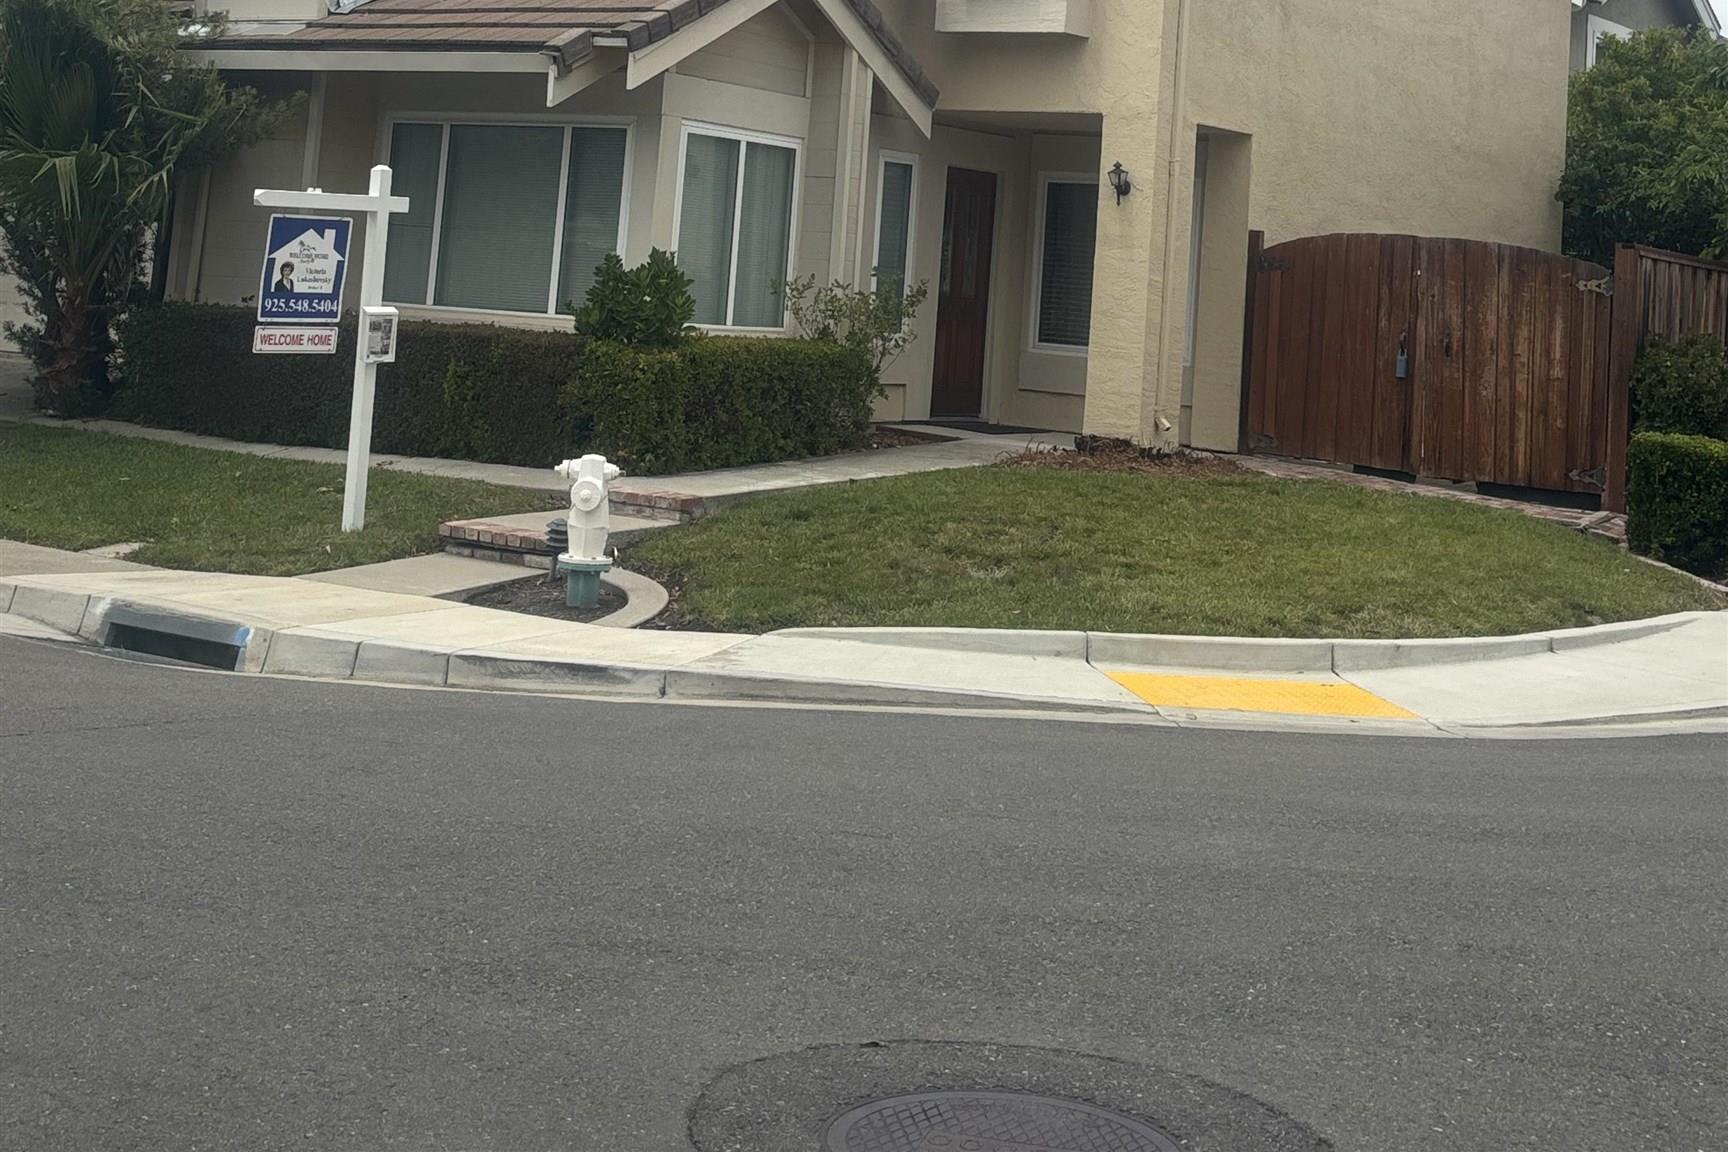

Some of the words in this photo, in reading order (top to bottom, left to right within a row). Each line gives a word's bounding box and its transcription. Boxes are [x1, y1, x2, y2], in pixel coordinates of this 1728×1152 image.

[264, 298, 338, 313] 925.548.5404
[259, 334, 305, 346] WELCOME
[307, 334, 333, 346] HOME
